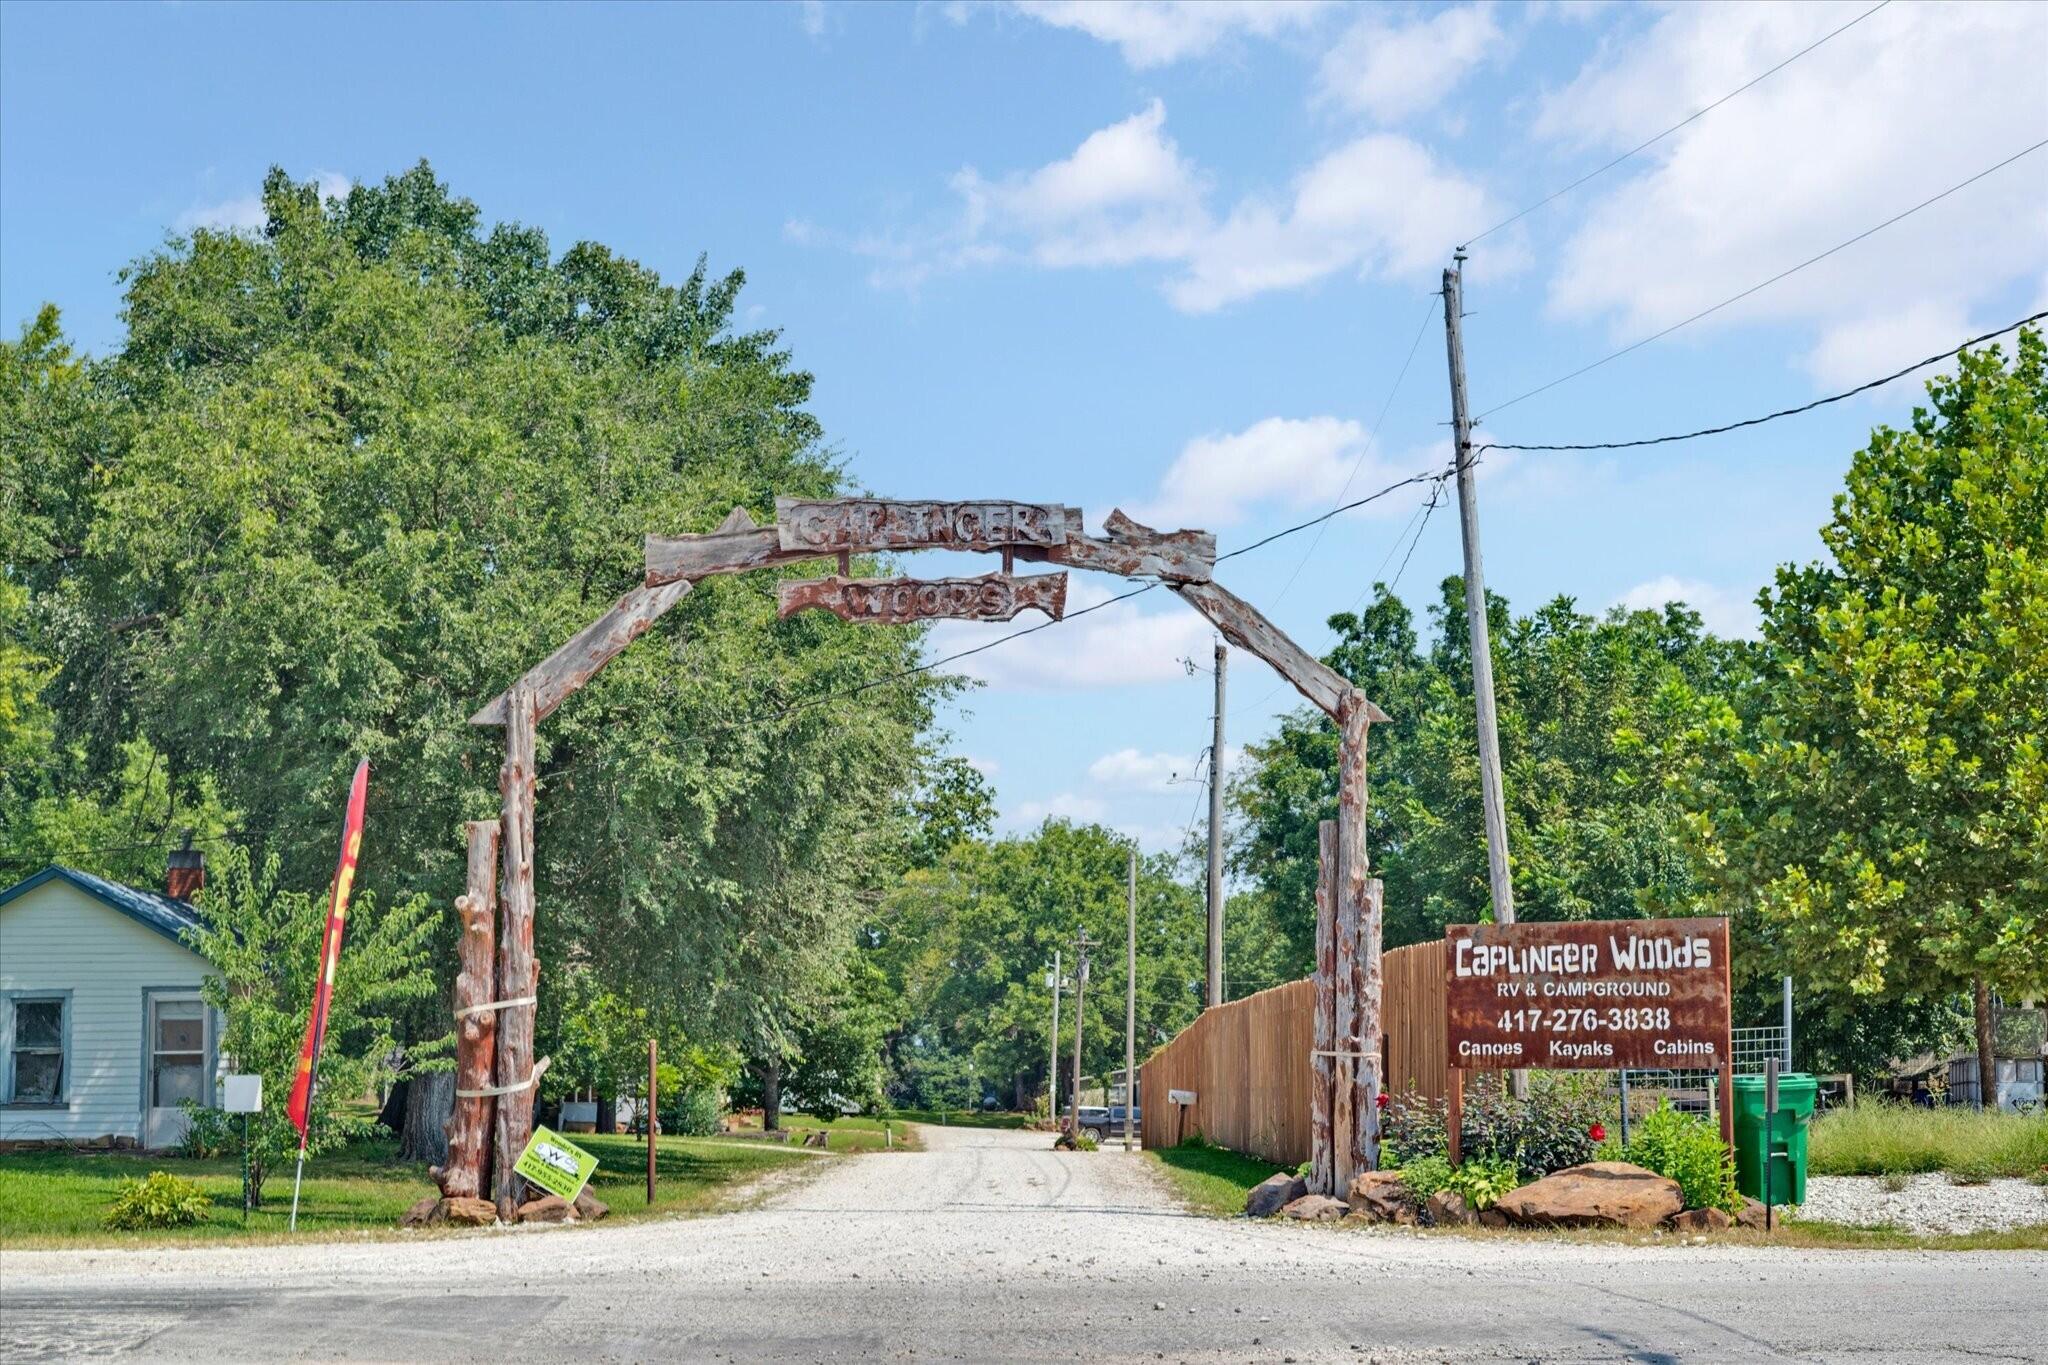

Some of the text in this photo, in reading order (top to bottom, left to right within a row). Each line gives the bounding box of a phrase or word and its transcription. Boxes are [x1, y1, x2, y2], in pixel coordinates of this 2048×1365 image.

[847, 581, 1005, 616] WOODS
[1497, 982, 1671, 997] RV & CAMPGROUND
[1497, 1007, 1671, 1032] 417-276-3838
[1458, 1039, 1715, 1060] Canoes Kayaks Cabins
